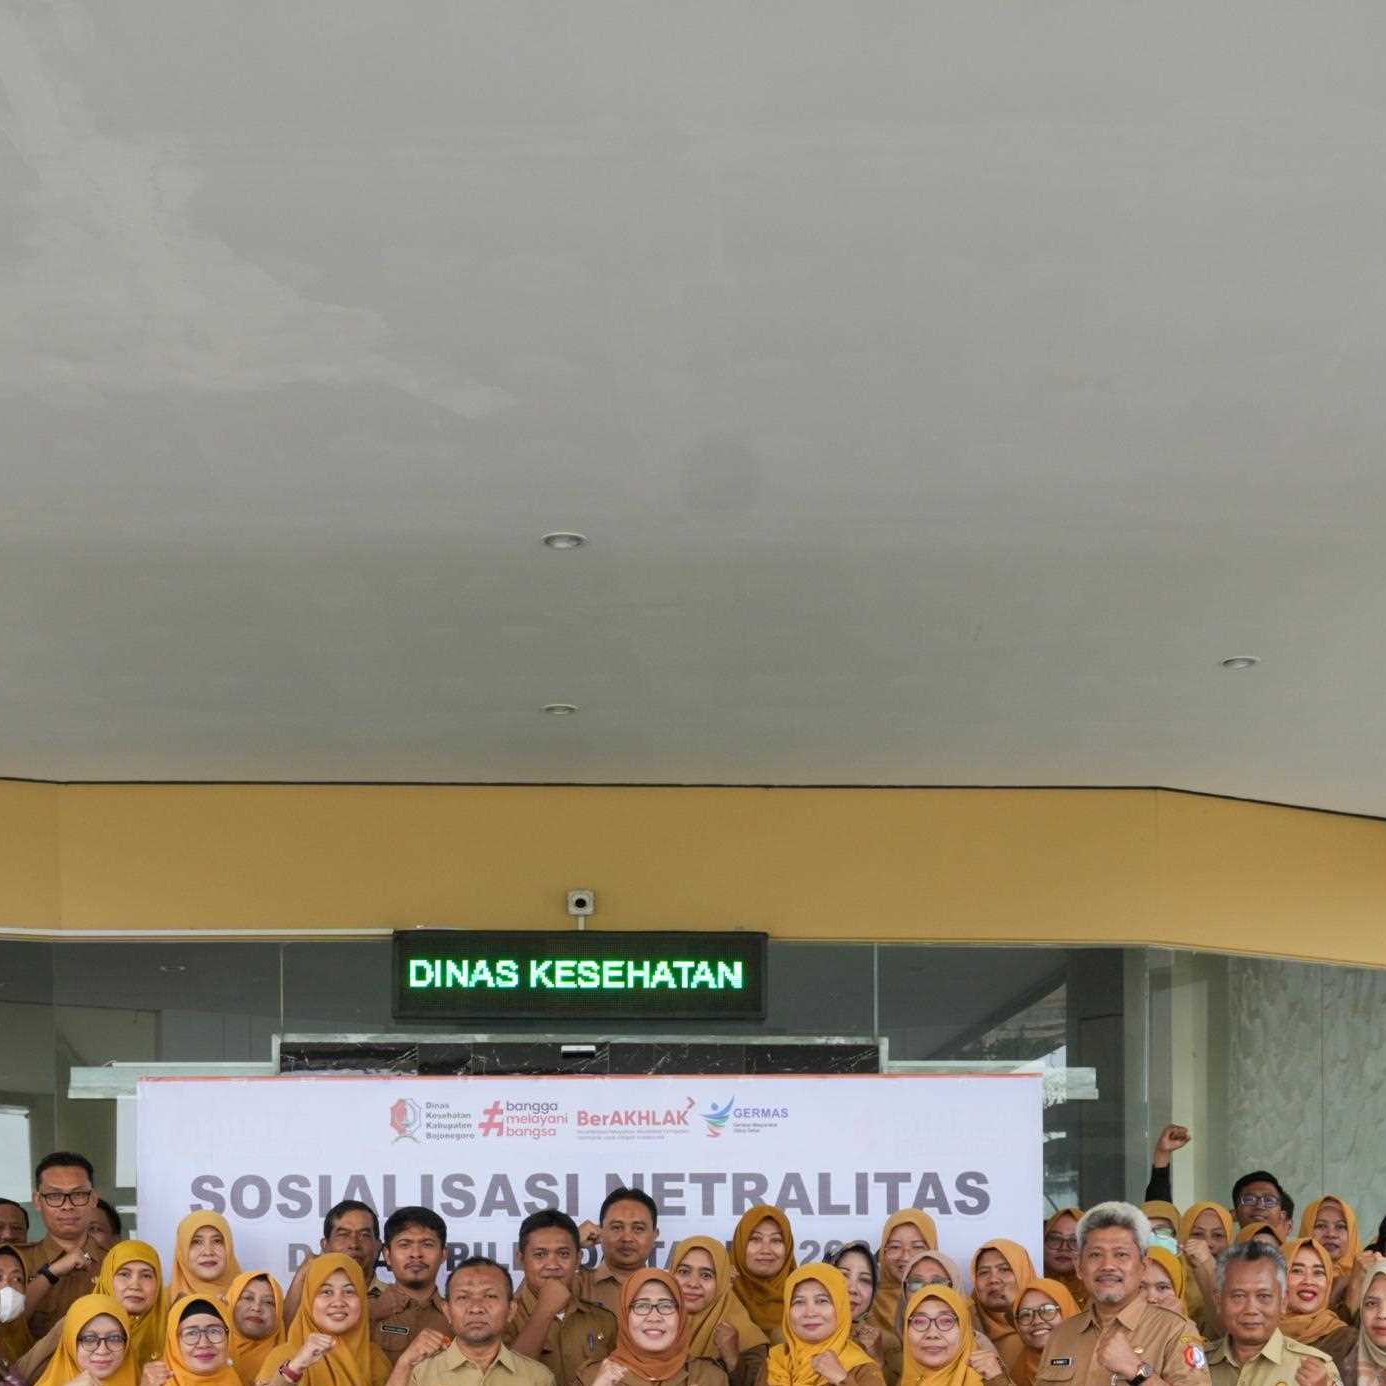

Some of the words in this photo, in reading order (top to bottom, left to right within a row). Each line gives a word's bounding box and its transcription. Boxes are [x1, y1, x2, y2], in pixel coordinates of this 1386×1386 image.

[409, 959, 518, 988] DINAS
[530, 960, 742, 989] KESEHATAN
[506, 1101, 558, 1115] bangga
[733, 1108, 789, 1119] GERMAS
[426, 1111, 471, 1119] Kesehatan
[506, 1113, 568, 1125] melayani
[577, 1110, 689, 1127] BerAKHLAK
[426, 1122, 472, 1130] Kabupaten
[426, 1132, 475, 1141] Bojonegoro
[506, 1126, 557, 1140] bangsa
[190, 1173, 579, 1219] SOSIALISASI
